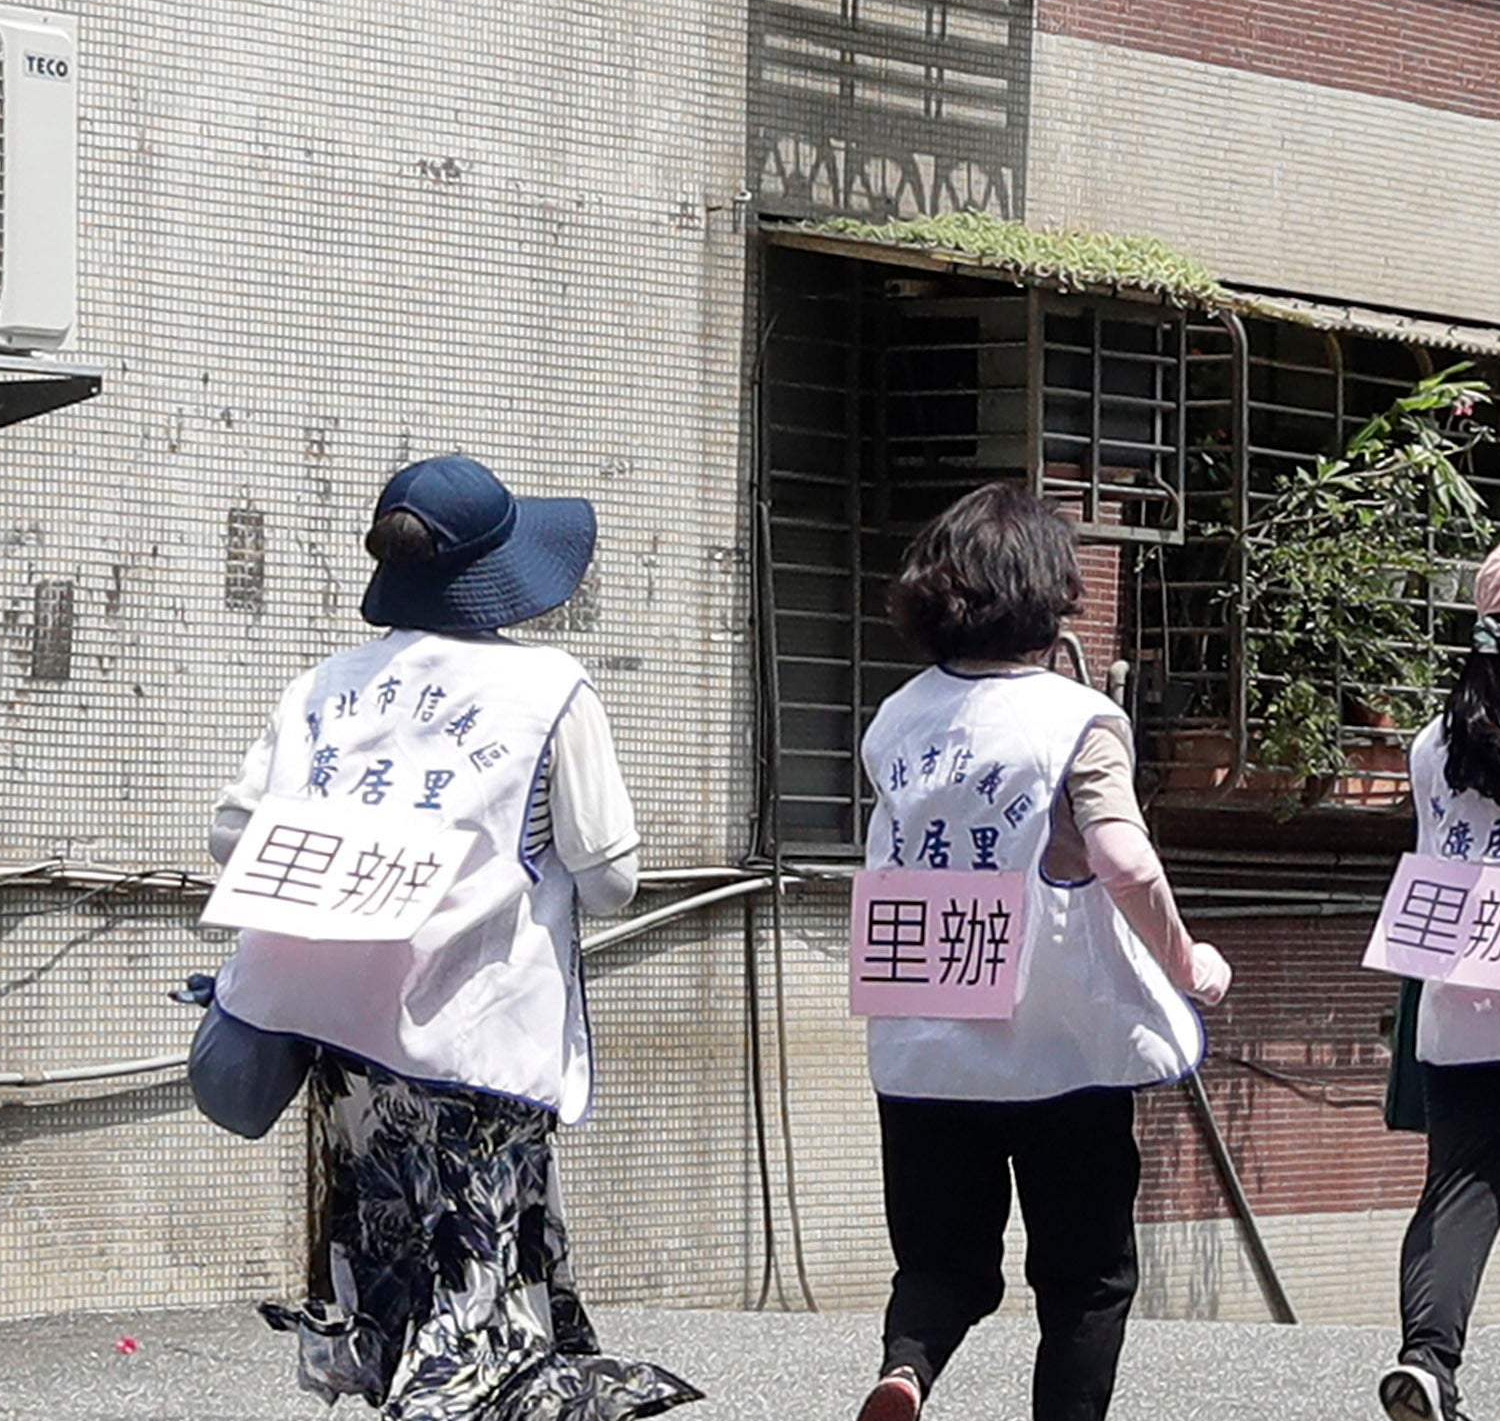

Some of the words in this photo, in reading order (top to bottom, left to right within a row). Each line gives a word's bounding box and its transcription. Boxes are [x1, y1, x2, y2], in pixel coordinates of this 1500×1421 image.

[26, 56, 68, 78] TECO
[297, 742, 456, 811] 廣居里
[232, 824, 442, 919] 里辦
[859, 895, 1011, 987] 里辦
